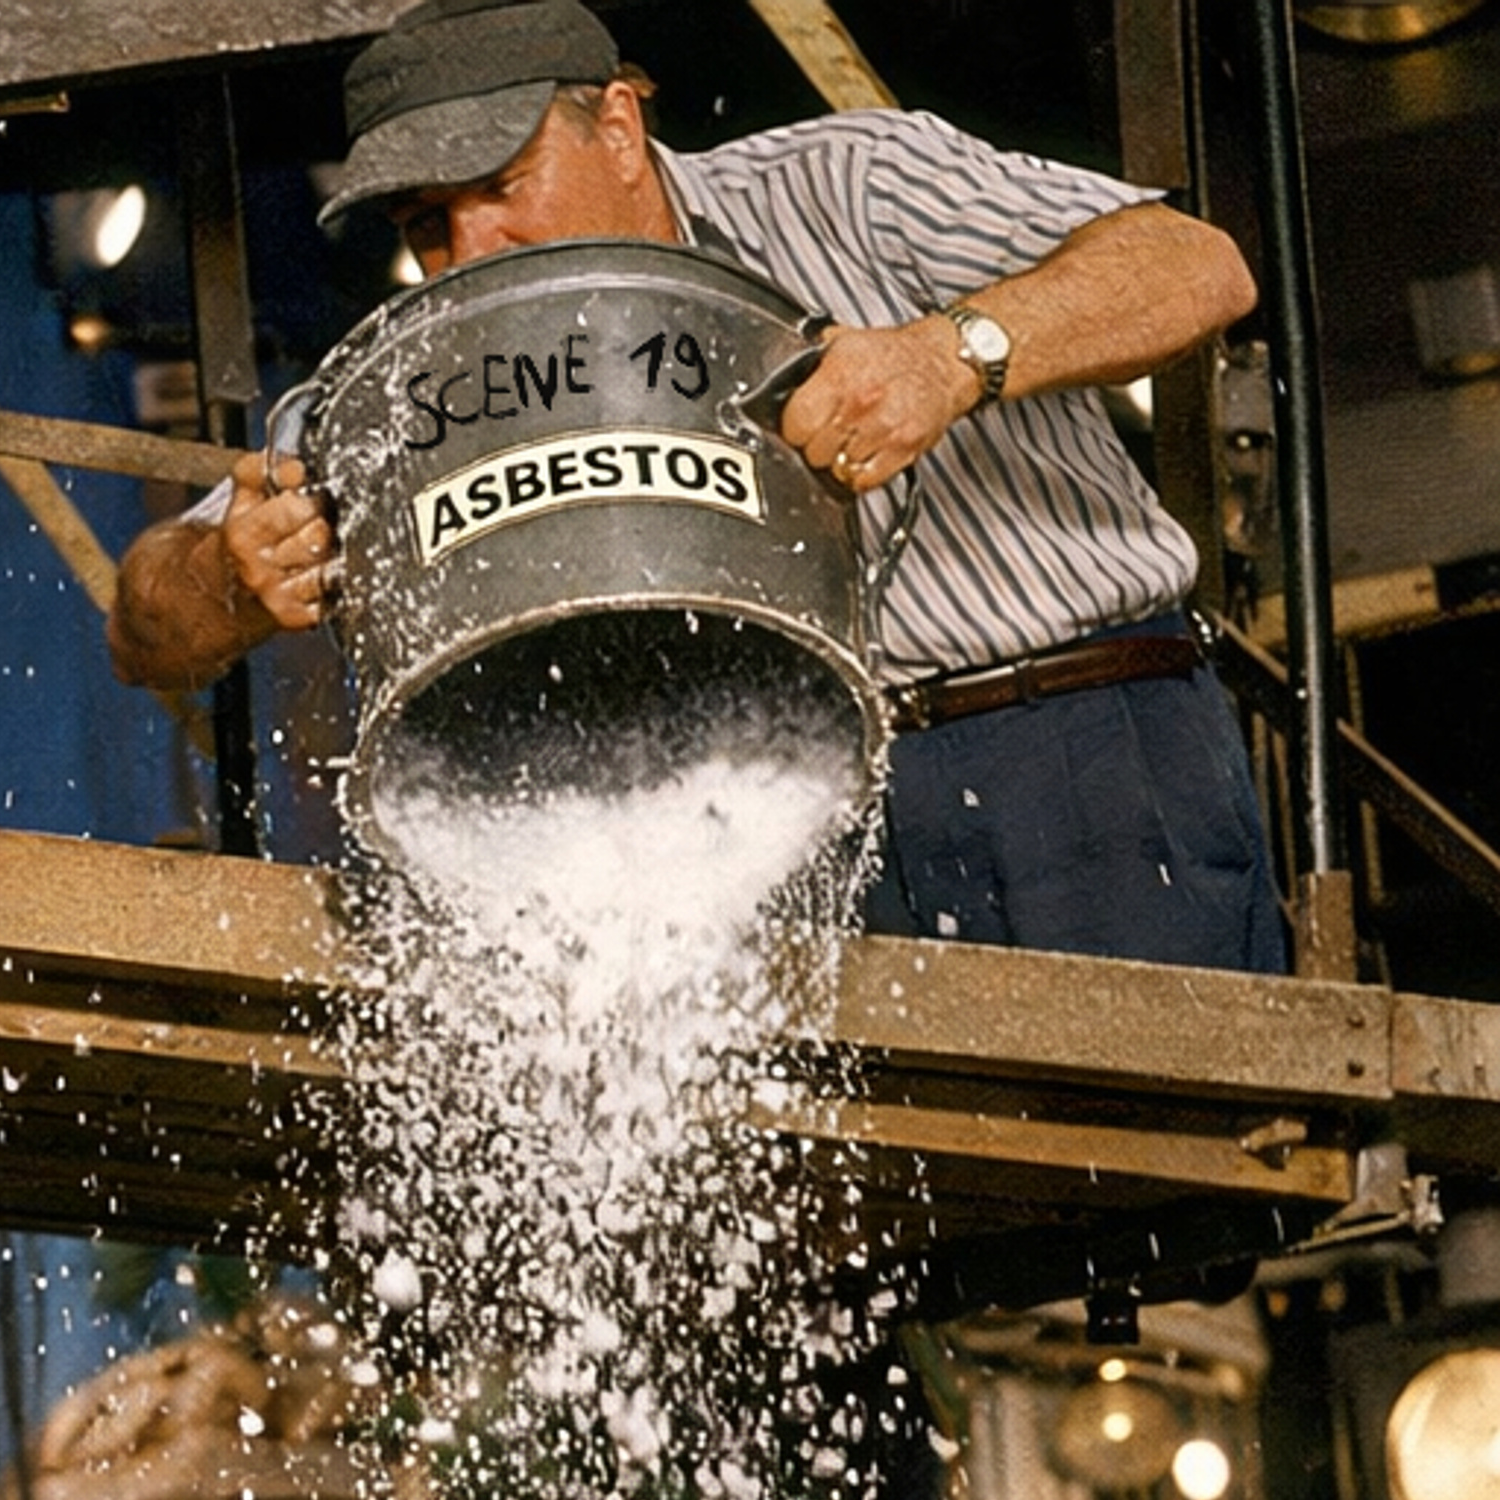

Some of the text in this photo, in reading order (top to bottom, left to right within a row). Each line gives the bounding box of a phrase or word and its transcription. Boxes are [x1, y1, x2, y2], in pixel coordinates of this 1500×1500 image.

[404, 331, 711, 449] SCENE 19
[430, 445, 748, 547] ASBESTOS
